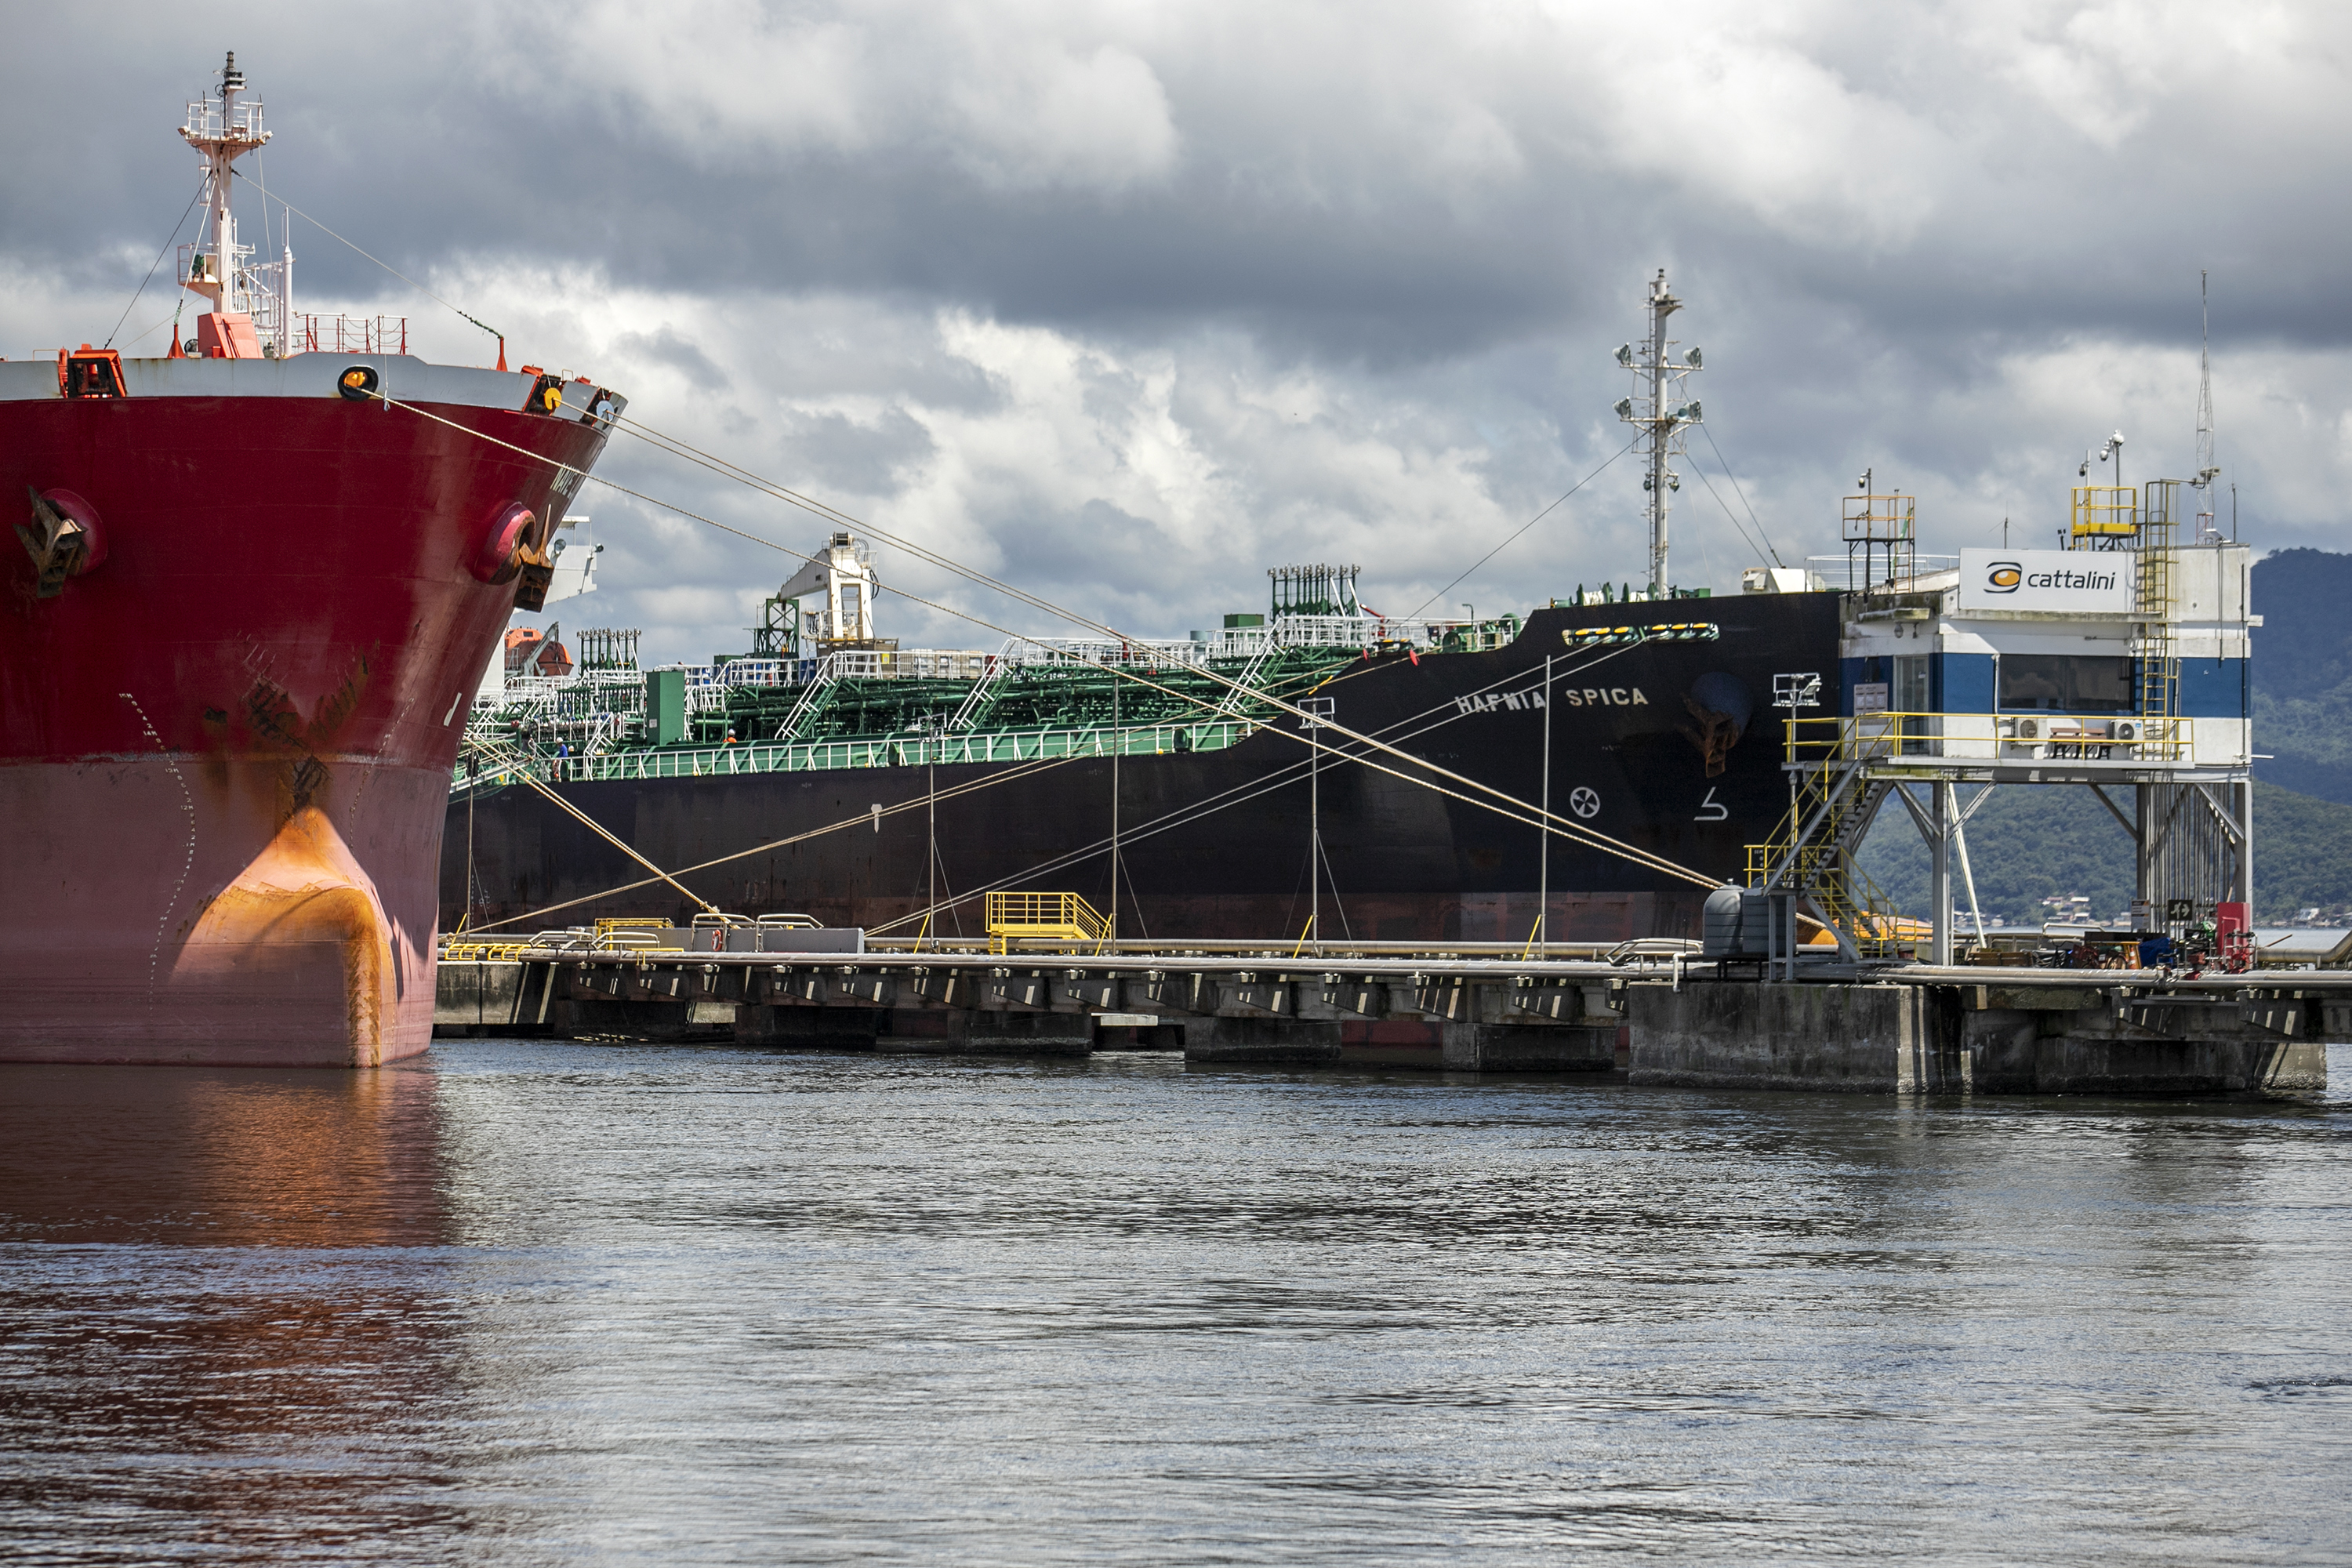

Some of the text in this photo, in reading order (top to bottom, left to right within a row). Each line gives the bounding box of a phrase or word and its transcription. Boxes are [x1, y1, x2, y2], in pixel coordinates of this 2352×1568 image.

[2027, 570, 2116, 590] cattalini
[1454, 688, 1648, 713] HAFNIA SPICA
